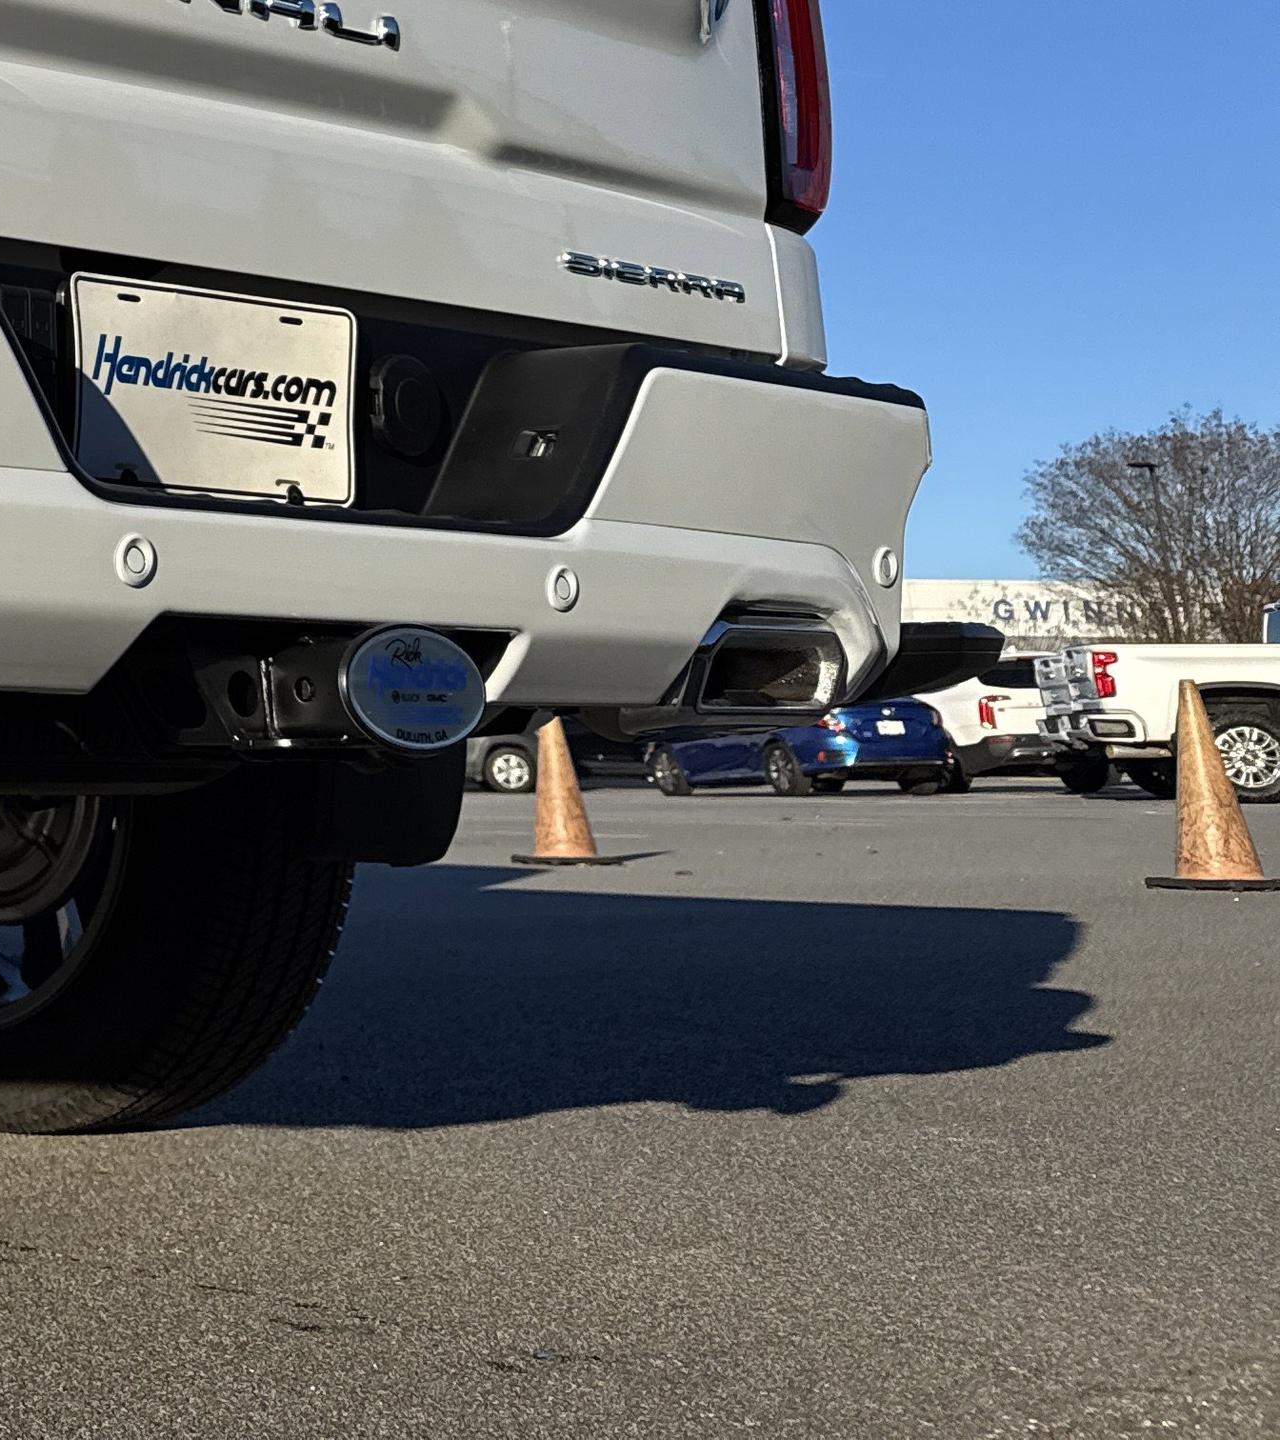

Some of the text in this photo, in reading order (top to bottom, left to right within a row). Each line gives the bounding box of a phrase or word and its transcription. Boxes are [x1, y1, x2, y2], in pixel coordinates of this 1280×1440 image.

[557, 251, 746, 304] SIERRA
[92, 334, 337, 407] Hendrickcars.com
[435, 729, 448, 741] GA
